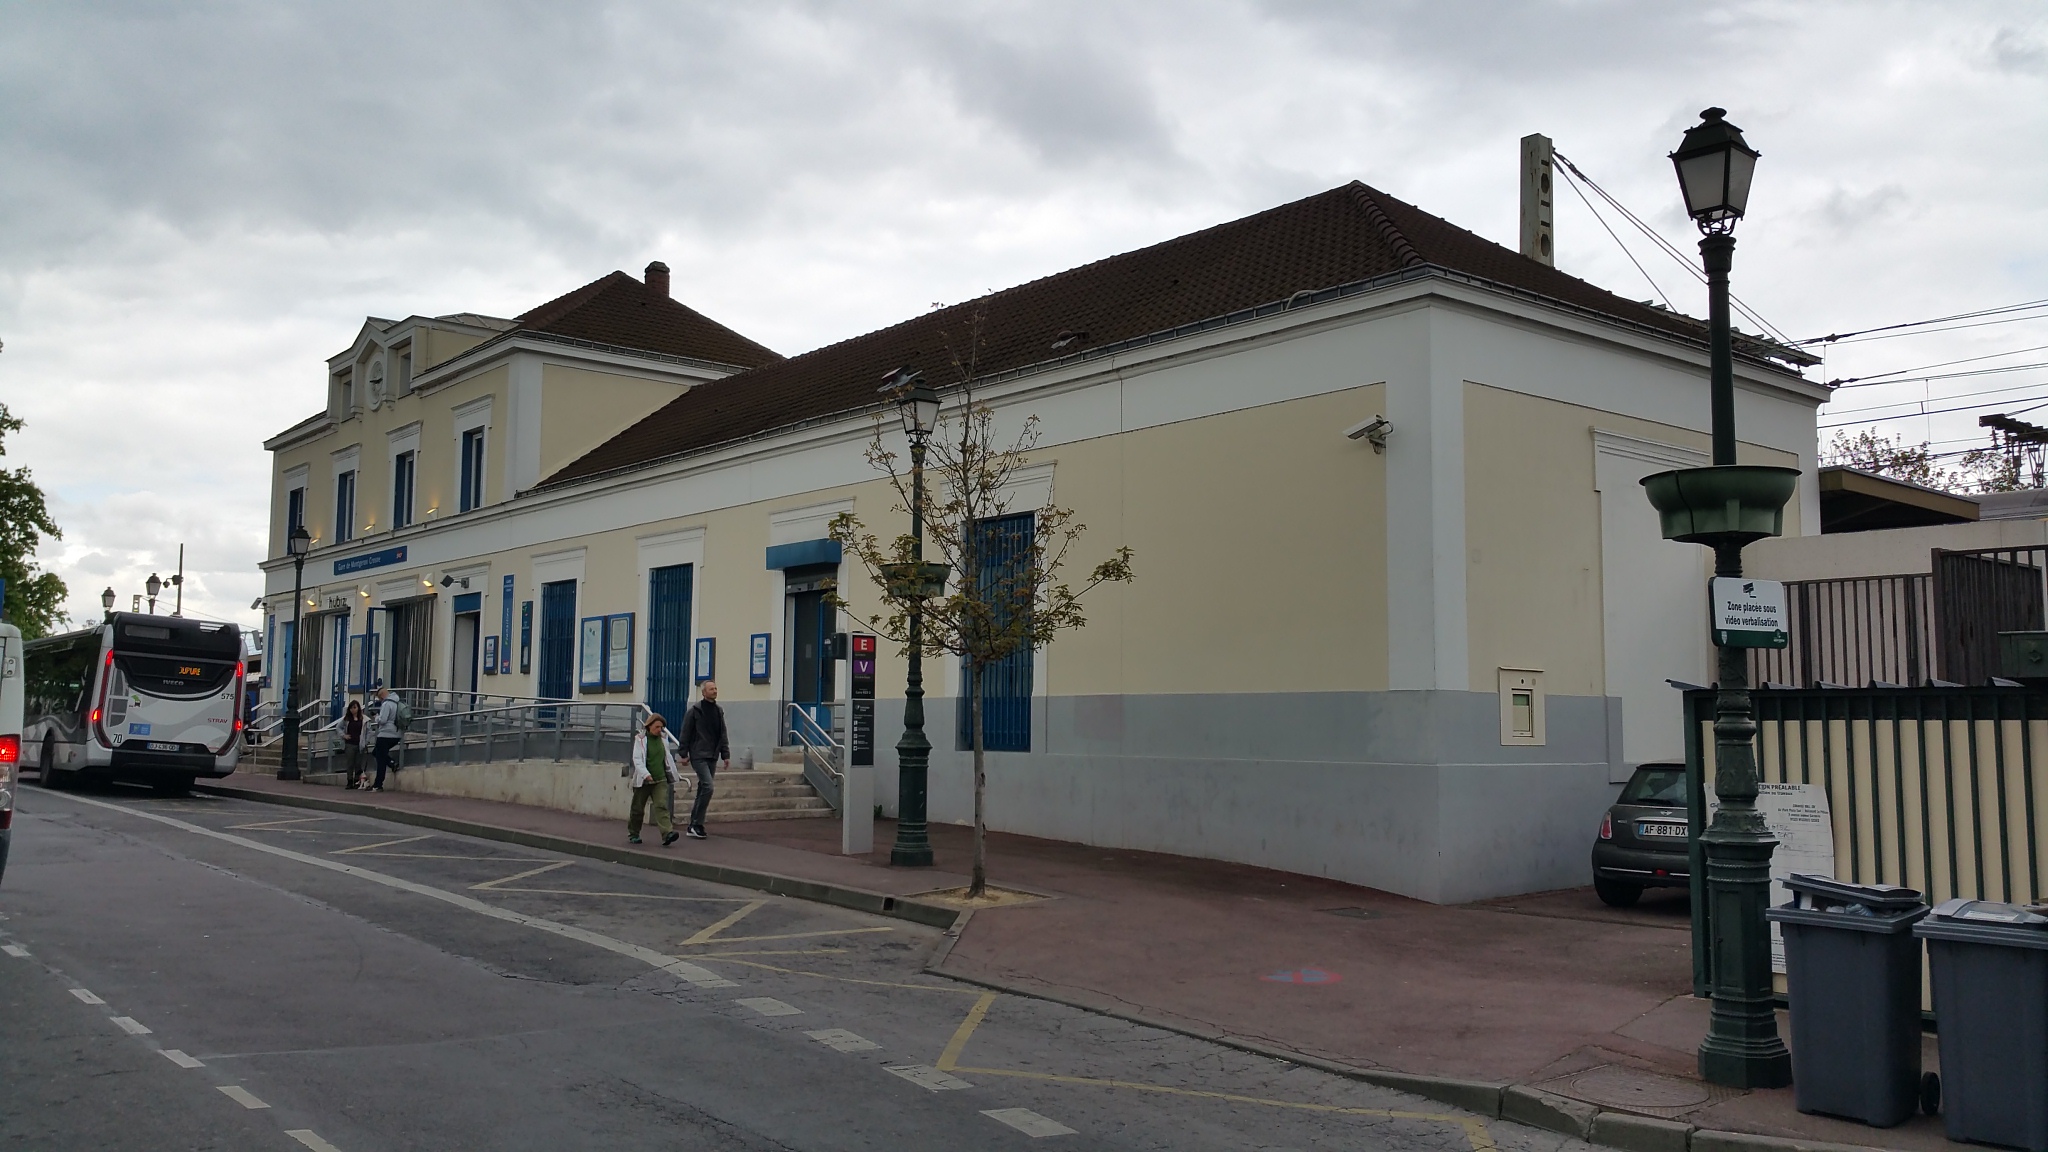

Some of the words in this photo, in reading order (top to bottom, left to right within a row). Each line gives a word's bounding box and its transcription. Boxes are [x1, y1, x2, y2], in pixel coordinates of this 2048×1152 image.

[1727, 601, 1742, 611] Zone
[1743, 602, 1762, 613] placée
[1763, 605, 1777, 613] sous
[1741, 616, 1779, 627] verbalisation
[861, 639, 868, 650] E
[859, 661, 869, 673] V
[221, 692, 235, 700] 575
[112, 733, 123, 744] 70
